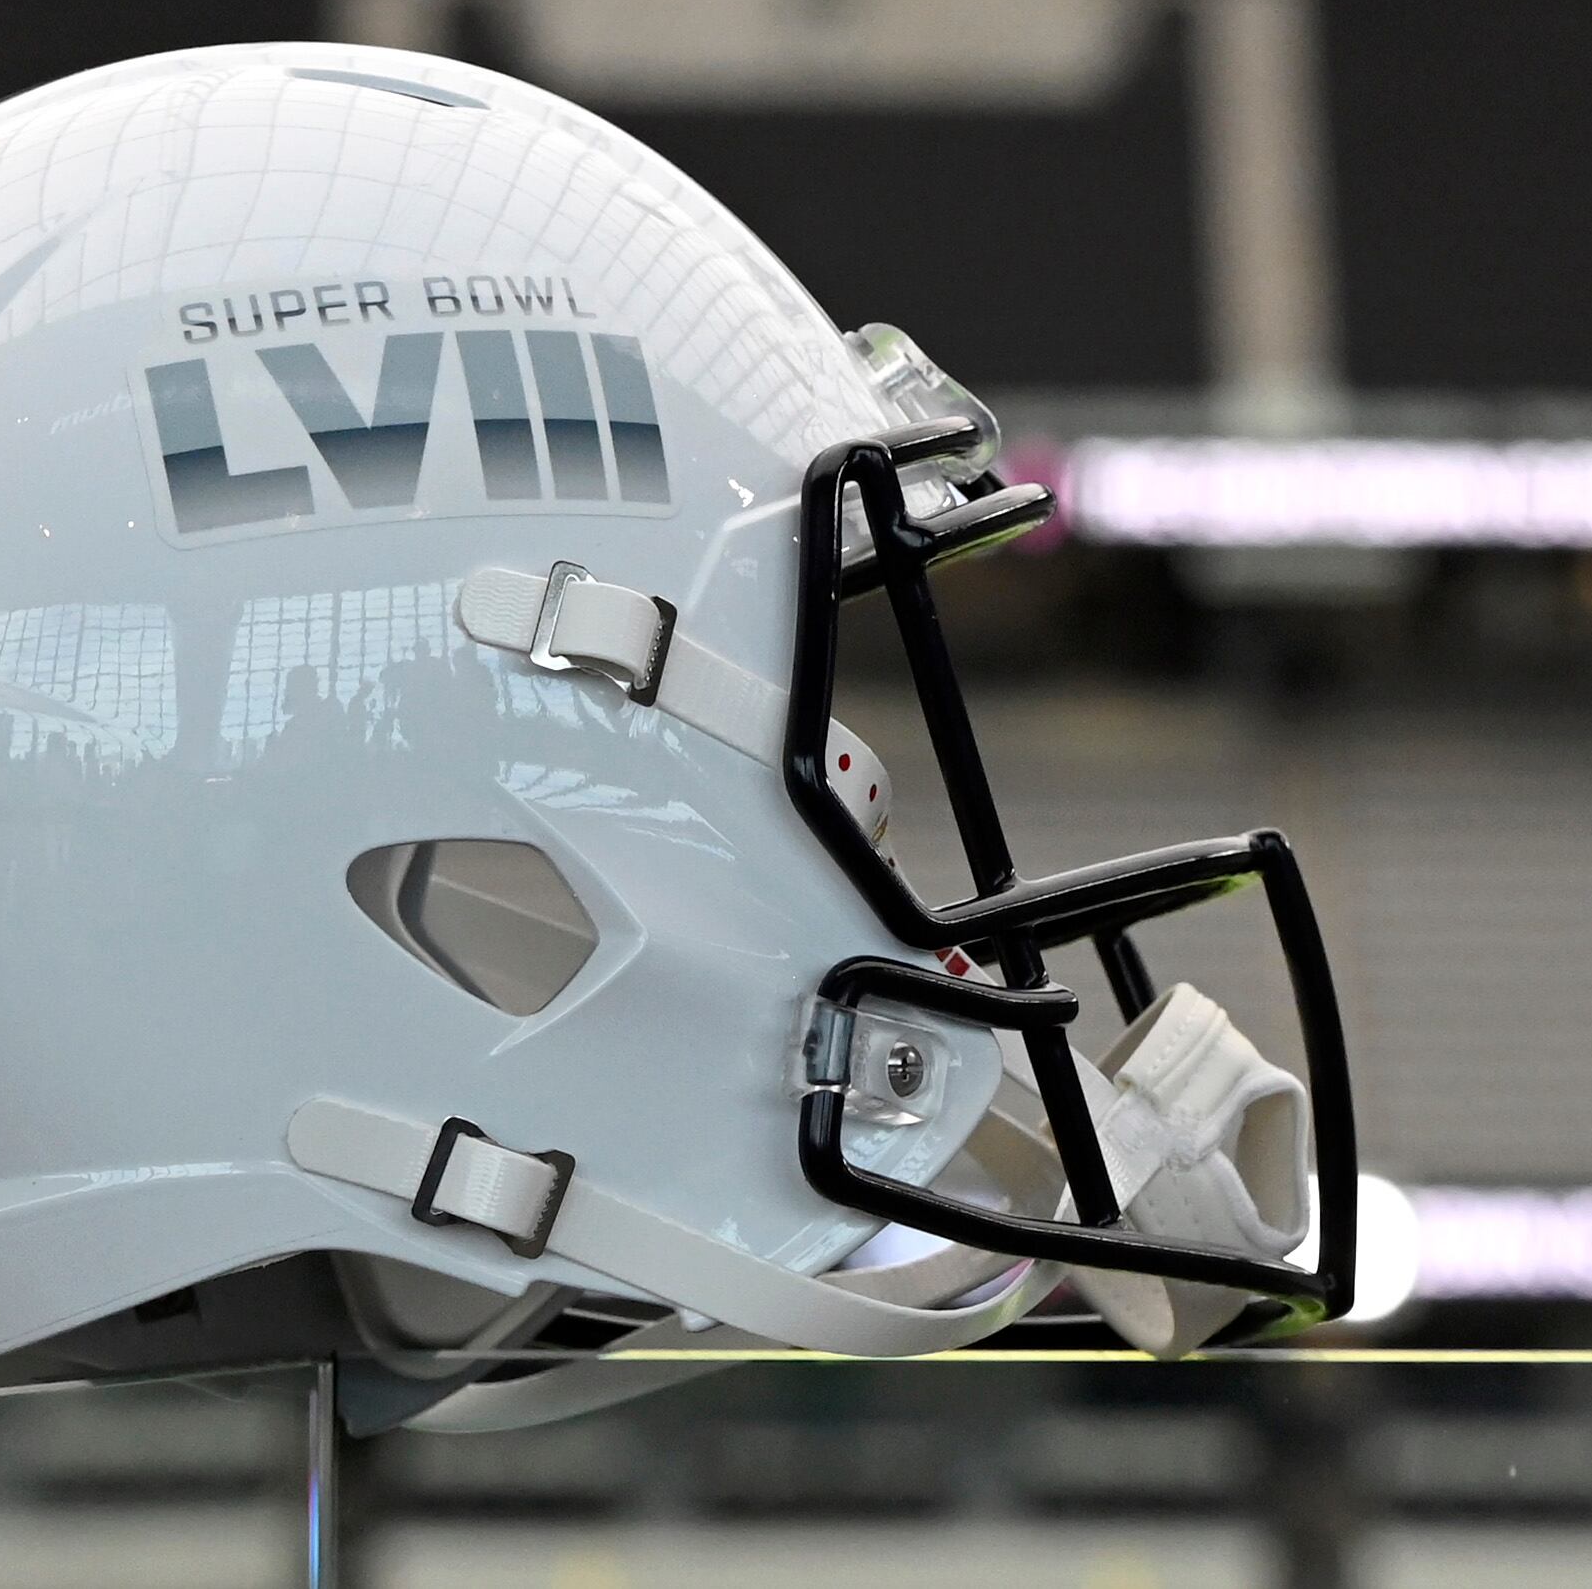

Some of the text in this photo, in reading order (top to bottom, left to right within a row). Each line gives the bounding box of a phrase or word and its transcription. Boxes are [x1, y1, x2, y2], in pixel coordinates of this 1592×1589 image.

[178, 274, 598, 345] SUPER BOWL
[144, 329, 672, 535] LVIII
